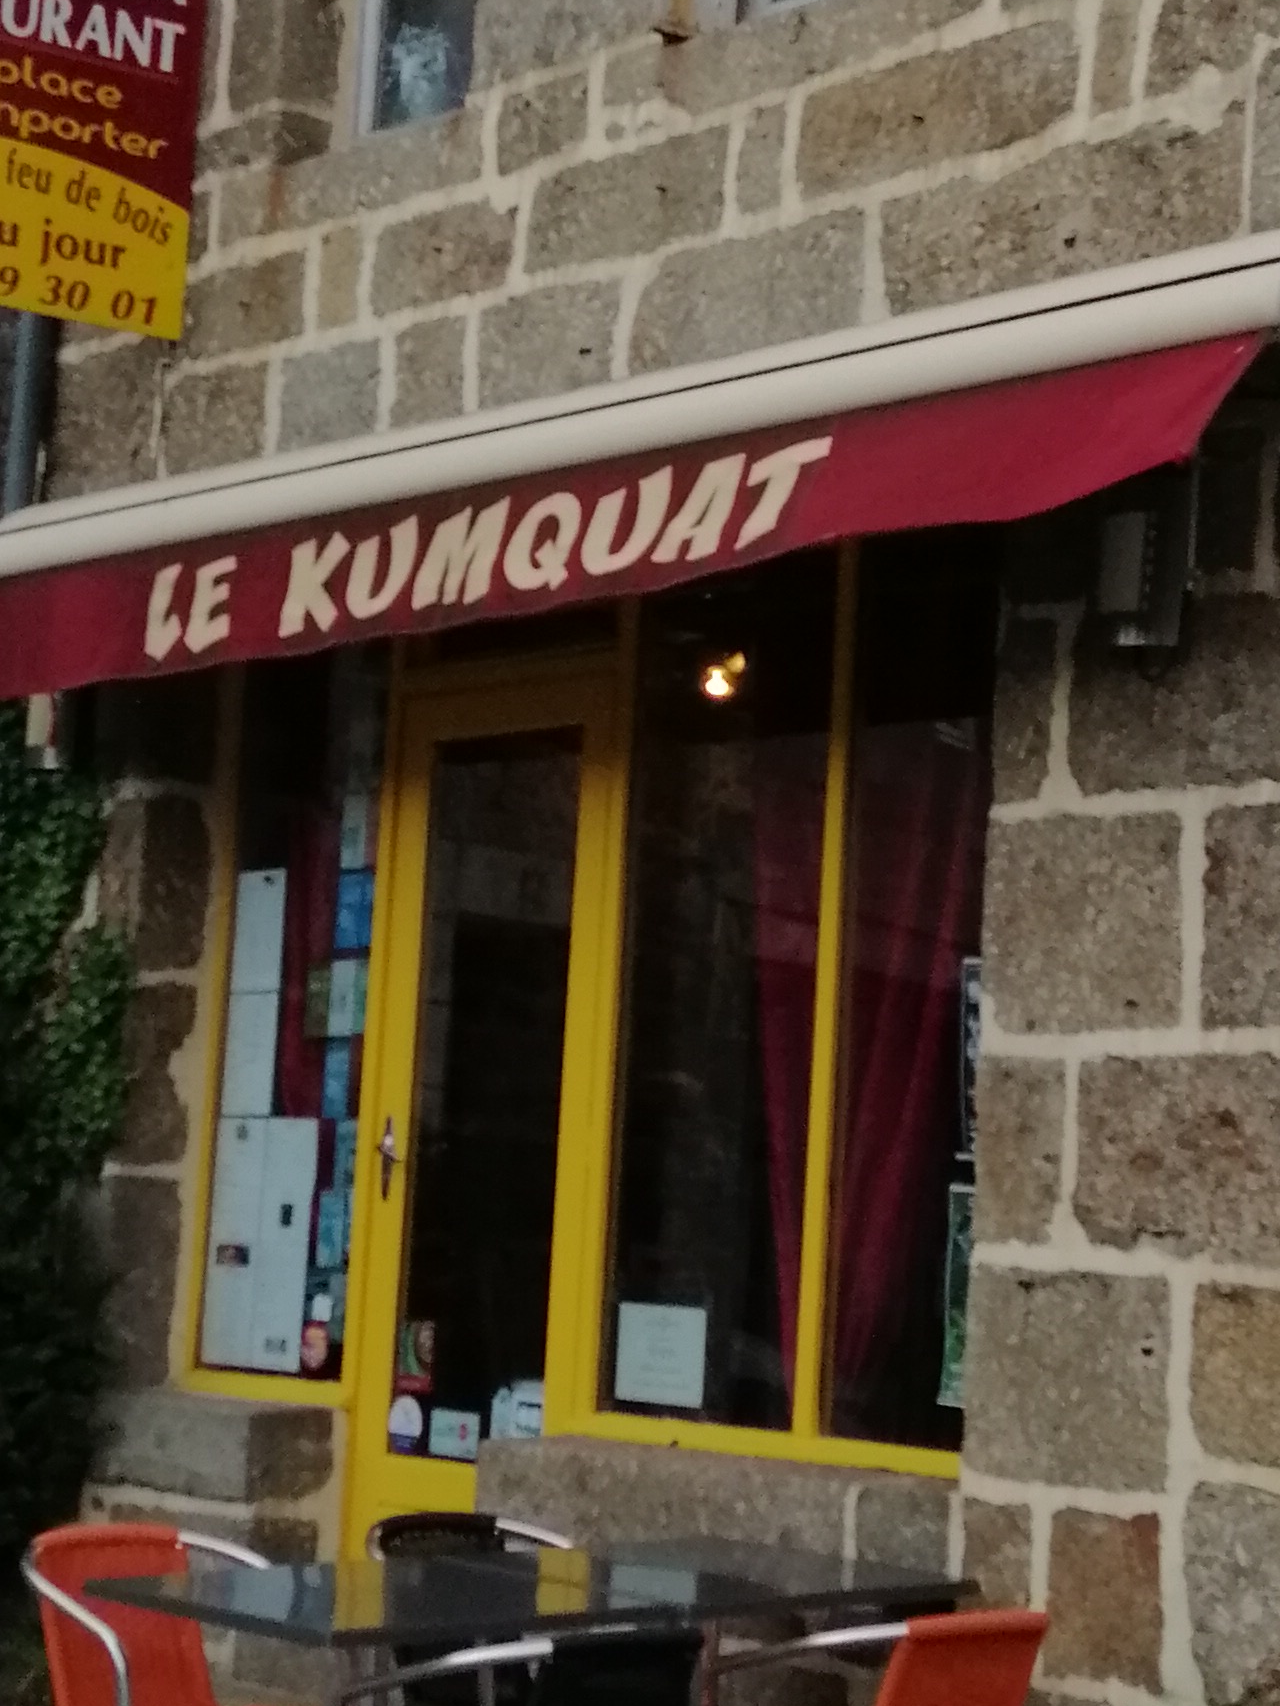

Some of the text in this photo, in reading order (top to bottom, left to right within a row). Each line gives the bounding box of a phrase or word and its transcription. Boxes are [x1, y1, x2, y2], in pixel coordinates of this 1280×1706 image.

[6, 147, 52, 195] feu
[65, 169, 102, 212] de
[112, 187, 174, 246] bois
[39, 218, 126, 271] jour
[38, 274, 91, 313] 30
[110, 290, 158, 326] 01
[144, 436, 834, 663] LE KUMQUAT
